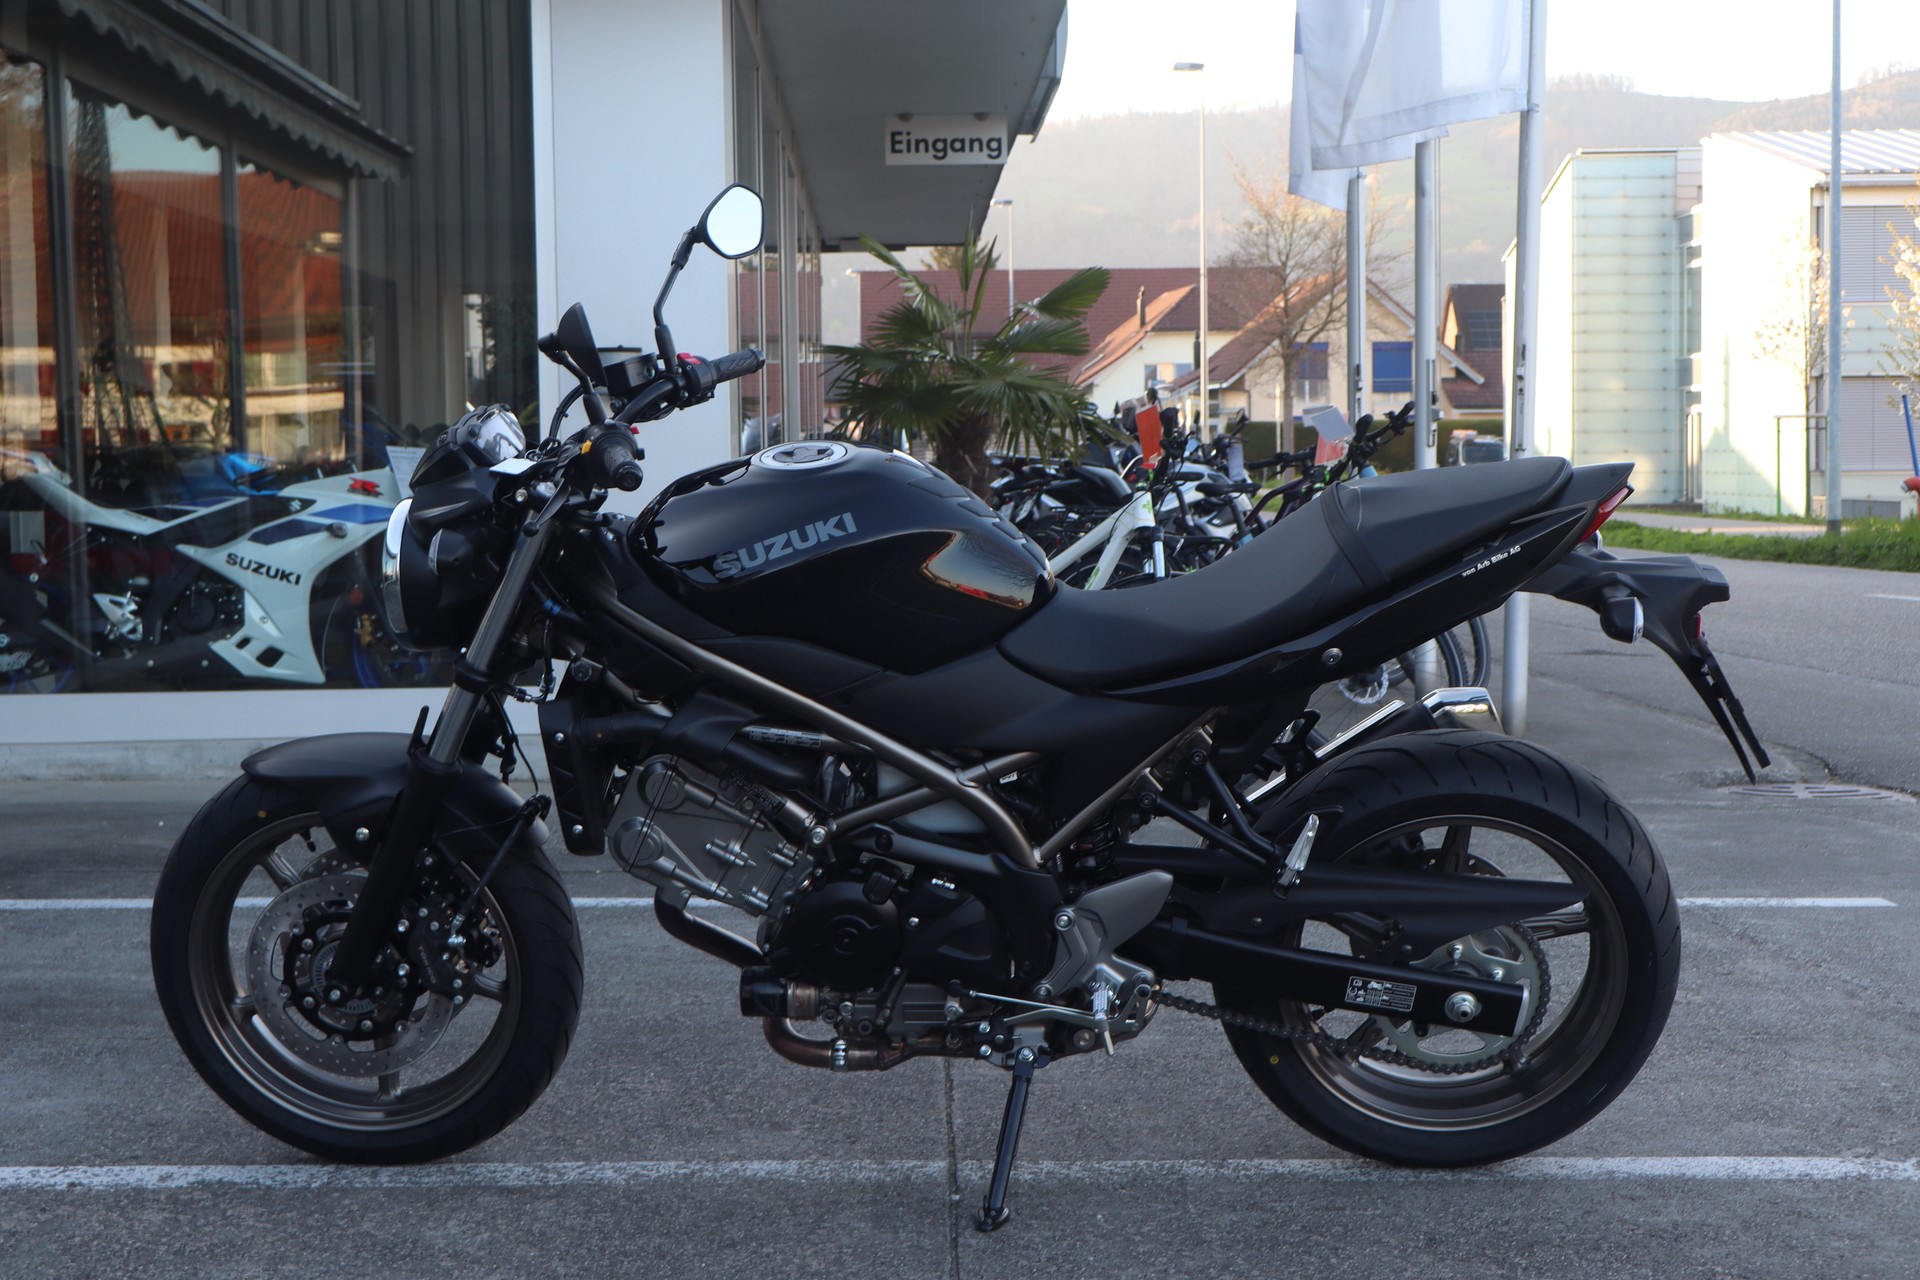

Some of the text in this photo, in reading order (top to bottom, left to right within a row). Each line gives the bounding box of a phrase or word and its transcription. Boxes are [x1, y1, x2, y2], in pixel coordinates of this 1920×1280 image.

[890, 131, 1002, 161] Eingang
[713, 511, 858, 579] SUZUKI
[1461, 545, 1521, 577] von Arb Bike AG
[225, 552, 302, 586] SUZUKI
